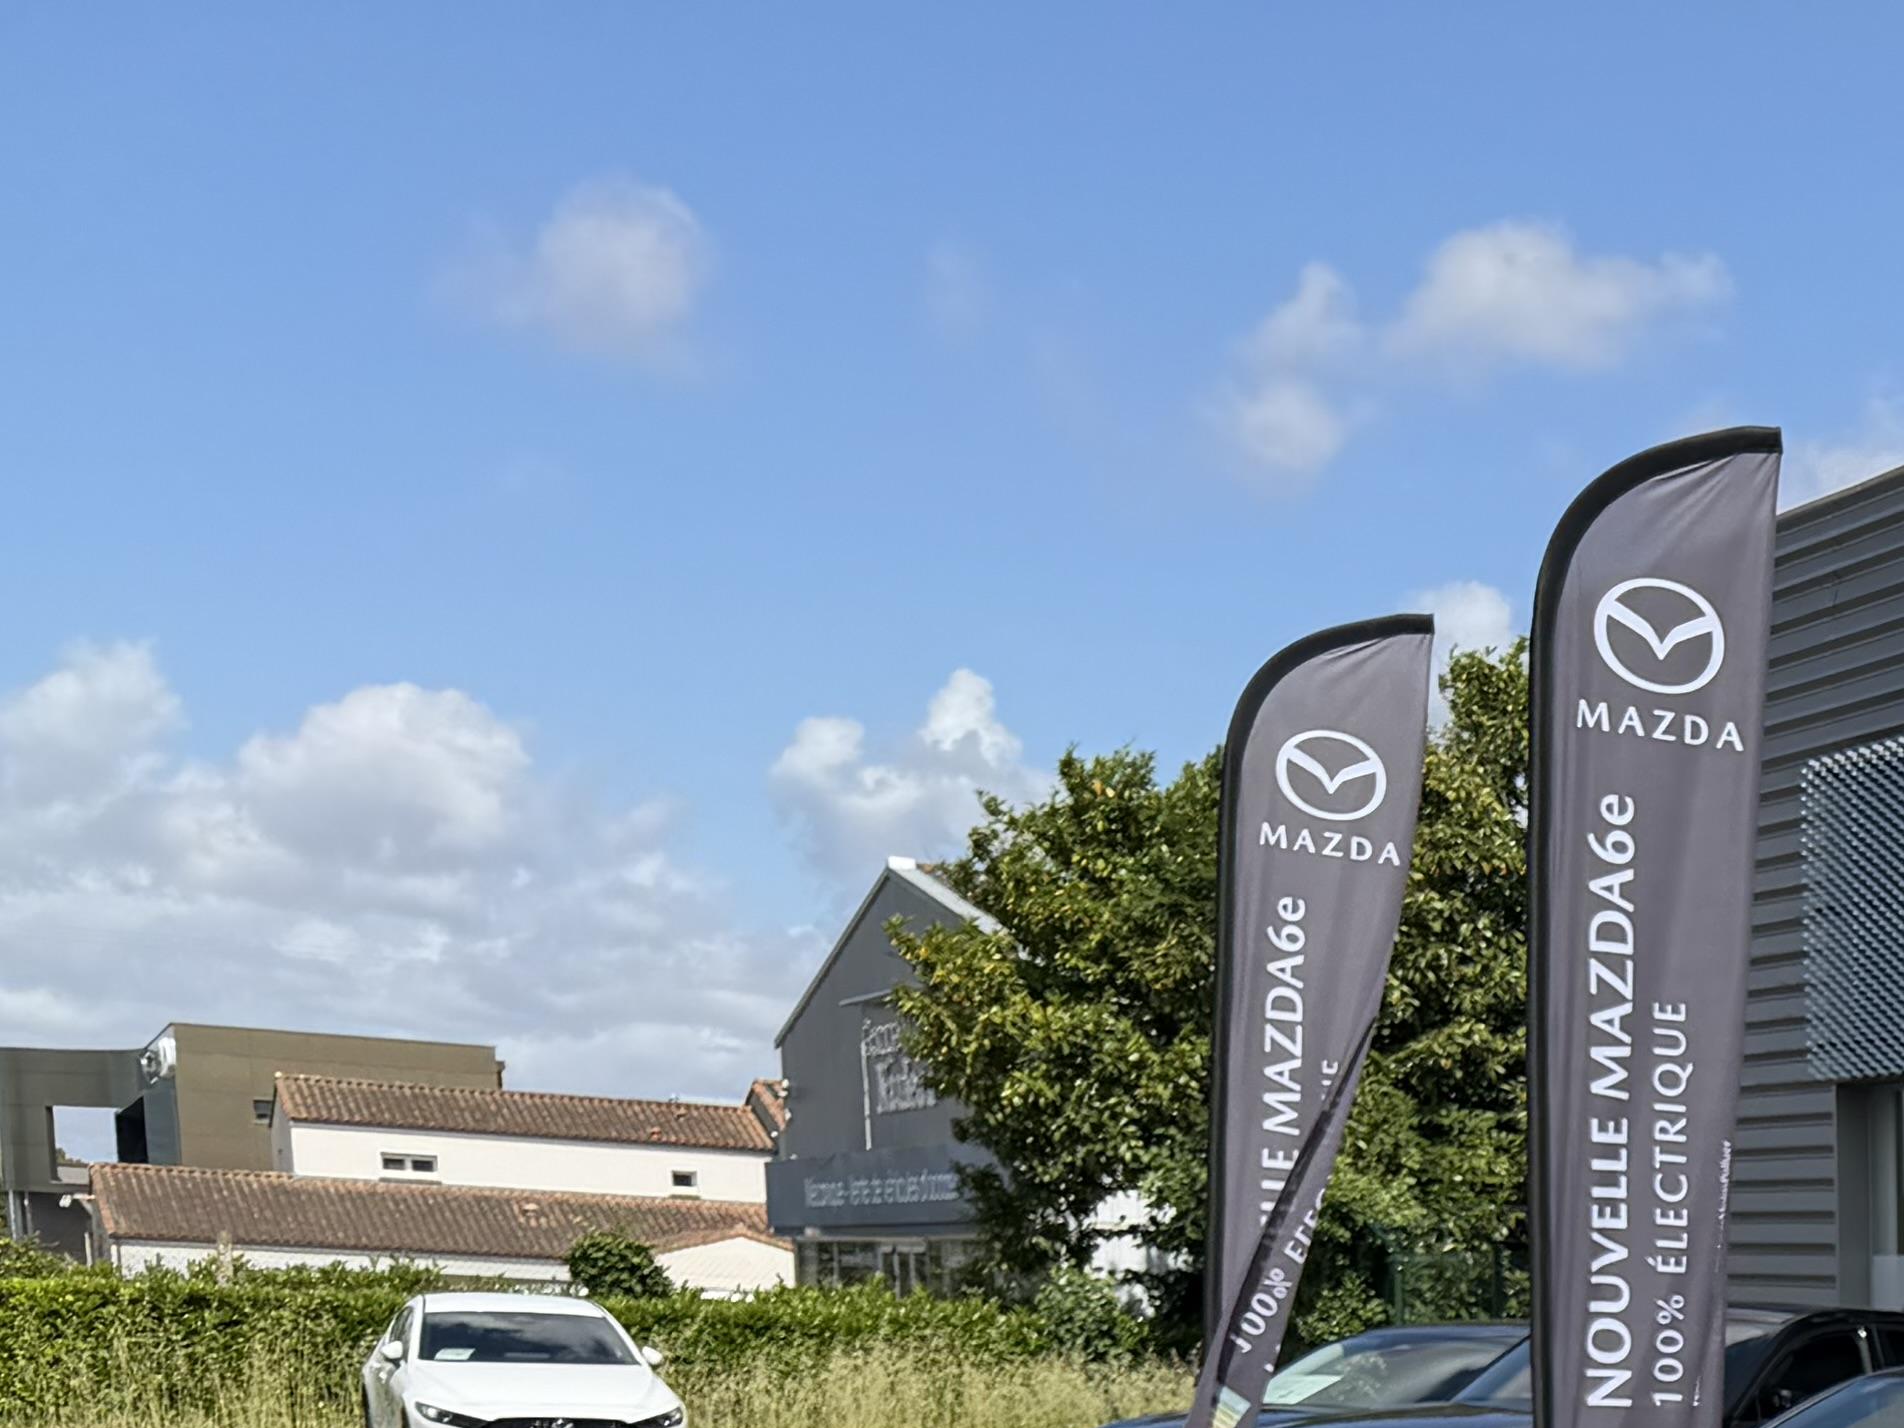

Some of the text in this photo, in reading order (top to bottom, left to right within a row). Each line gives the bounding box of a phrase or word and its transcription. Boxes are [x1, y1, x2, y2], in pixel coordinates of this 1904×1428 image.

[1258, 821, 1401, 867] MAZDA
[1575, 698, 1745, 752] MAZDA
[1262, 896, 1306, 1136] MAZDA6e
[1586, 794, 1635, 1408] NOUVELLE MAZDA6e
[1645, 1001, 1694, 1407] 100% ÉLECTRIQUE
